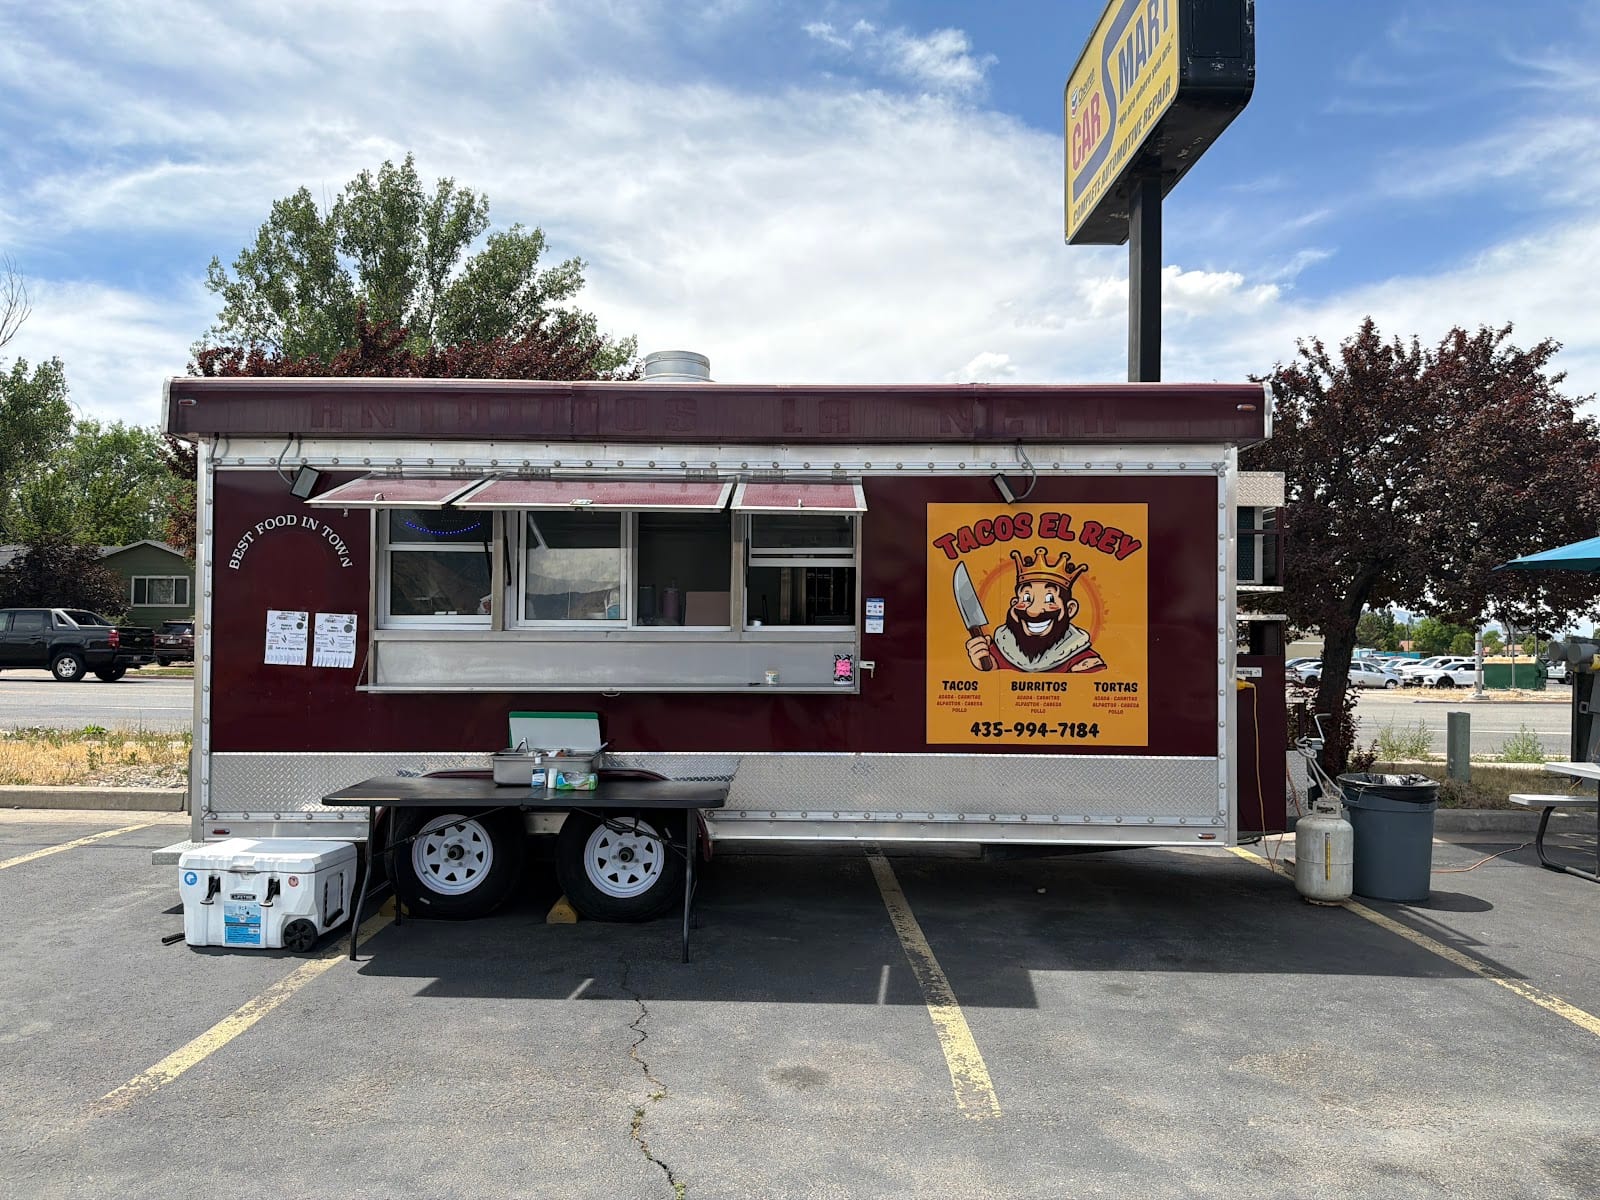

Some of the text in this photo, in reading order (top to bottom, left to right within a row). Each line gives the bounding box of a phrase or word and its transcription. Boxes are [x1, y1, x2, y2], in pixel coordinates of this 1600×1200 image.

[1072, 90, 1101, 171] CAR
[1072, 74, 1171, 226] COMPLETE AUTOMOTIVE REPAIR
[229, 514, 353, 570] BEST FOOD IN TOWN
[933, 512, 1143, 560] TACOS EL REY
[942, 680, 1138, 693] TACOS BURRITOS TORTAS
[970, 721, 1100, 738] 435-994-7184
